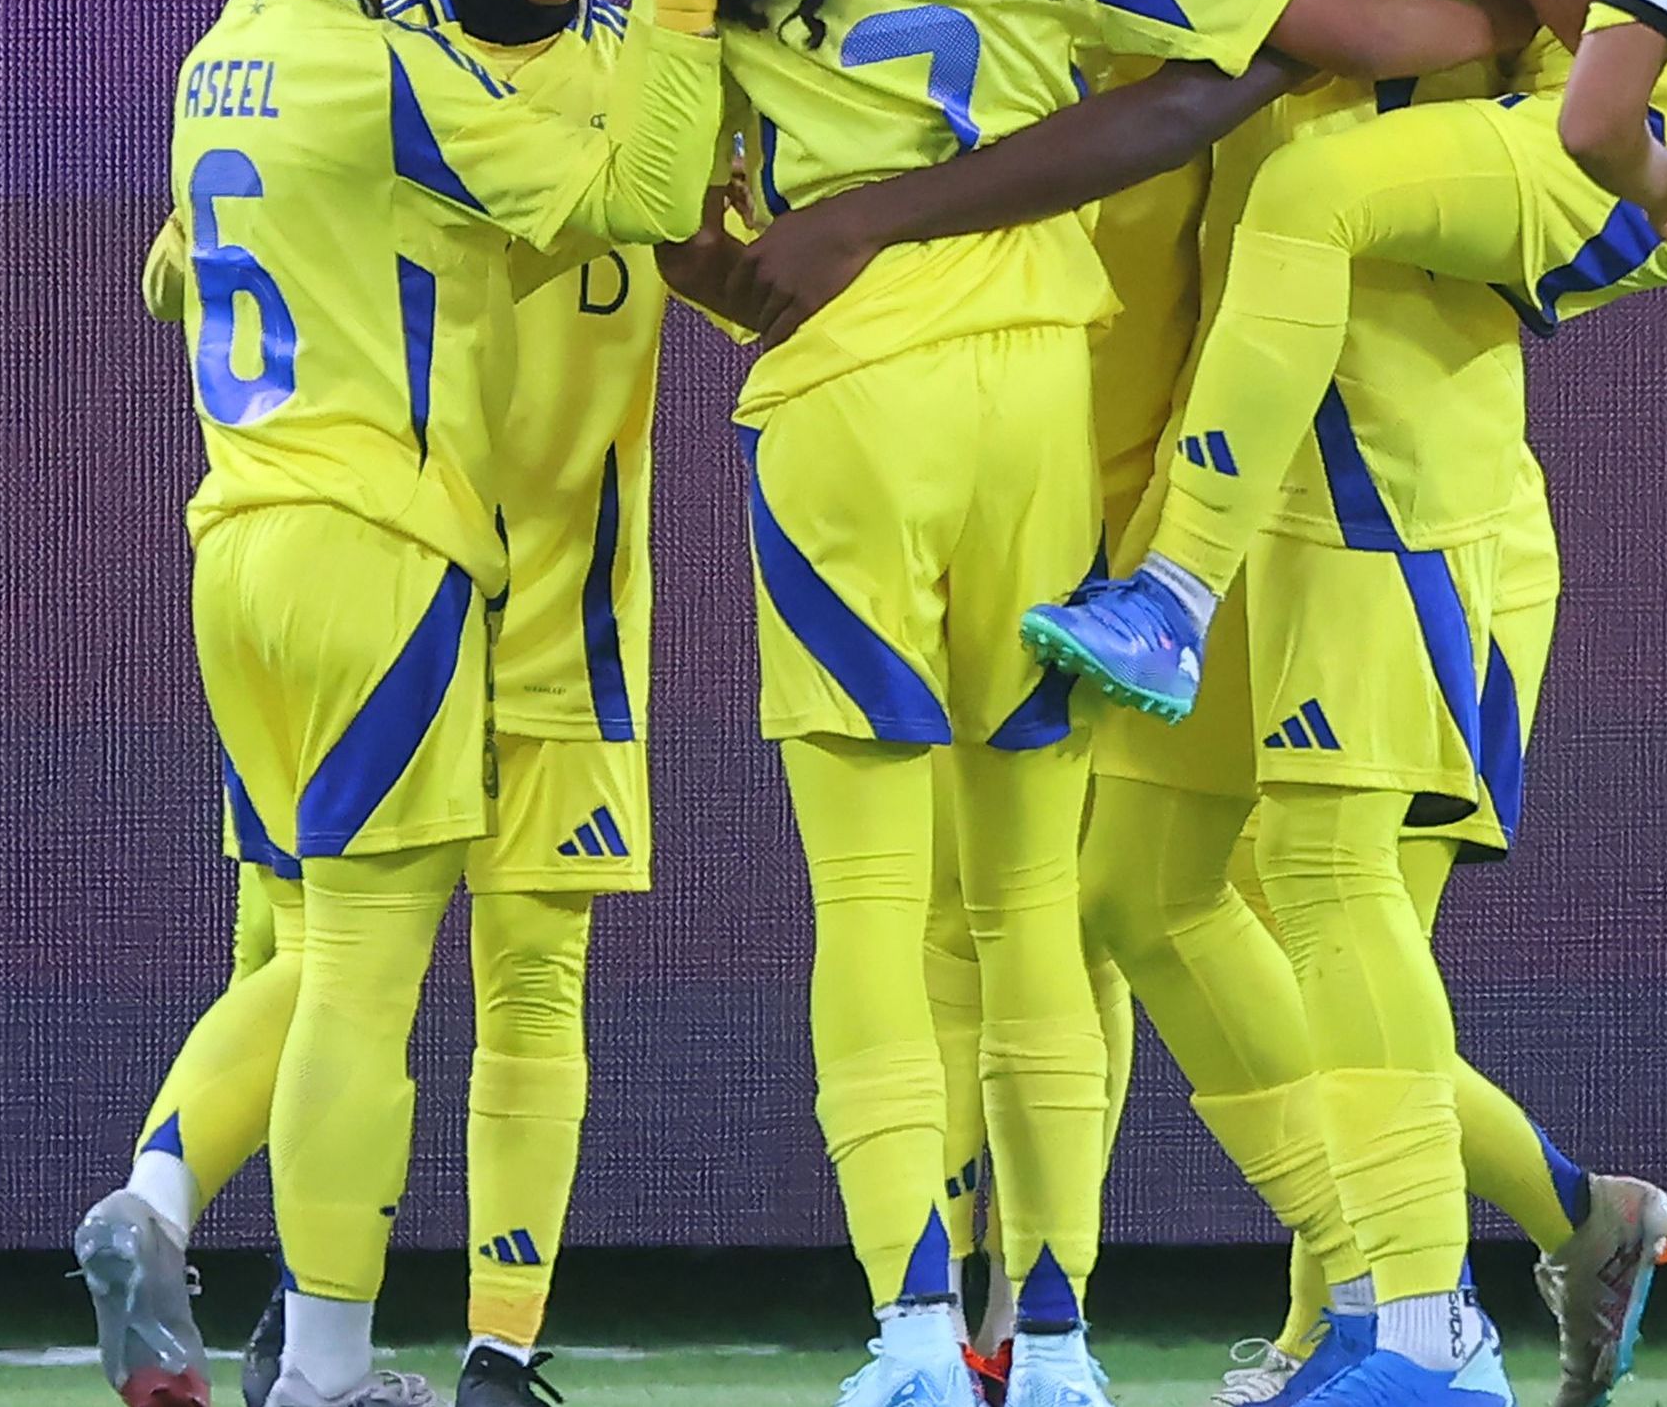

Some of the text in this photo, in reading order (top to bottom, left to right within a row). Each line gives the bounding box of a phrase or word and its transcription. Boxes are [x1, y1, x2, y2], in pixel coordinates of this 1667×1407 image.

[184, 60, 280, 118] ASEEL
[840, 4, 981, 155] 7
[189, 148, 295, 426] 6
